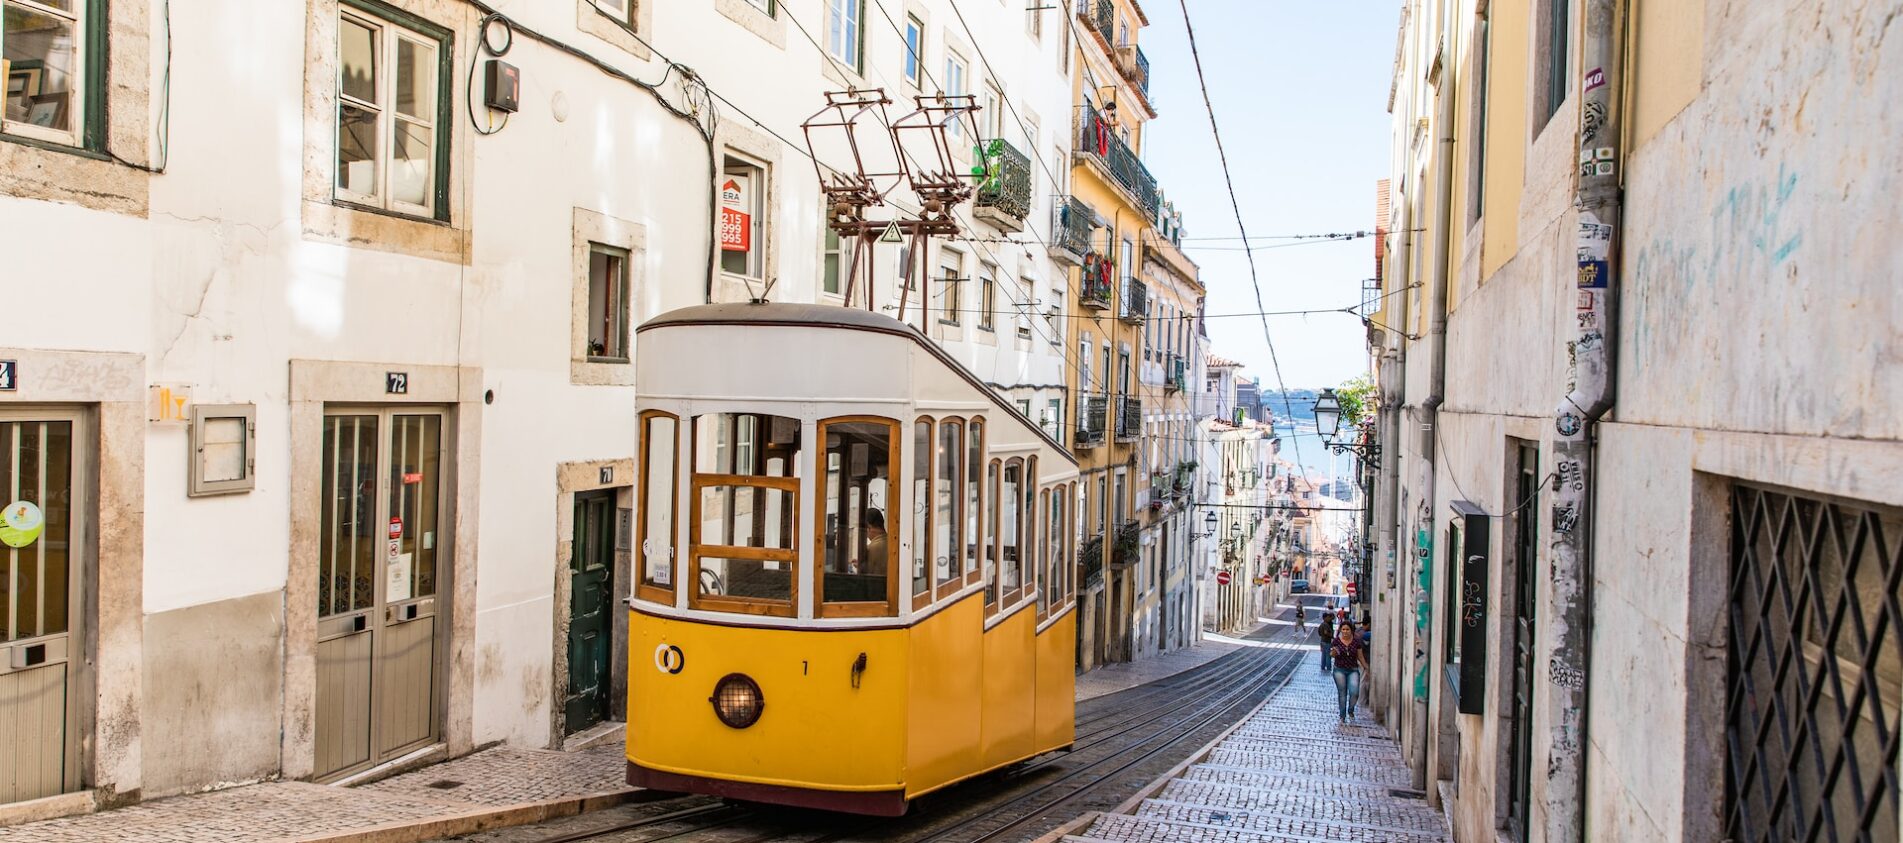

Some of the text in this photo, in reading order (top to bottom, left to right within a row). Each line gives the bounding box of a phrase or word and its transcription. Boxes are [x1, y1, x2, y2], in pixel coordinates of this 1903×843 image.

[723, 191, 740, 201] ERA
[722, 213, 742, 224] 215
[722, 223, 742, 234] 999
[722, 233, 742, 244] 995
[390, 373, 405, 393] 72
[602, 468, 612, 483] 70
